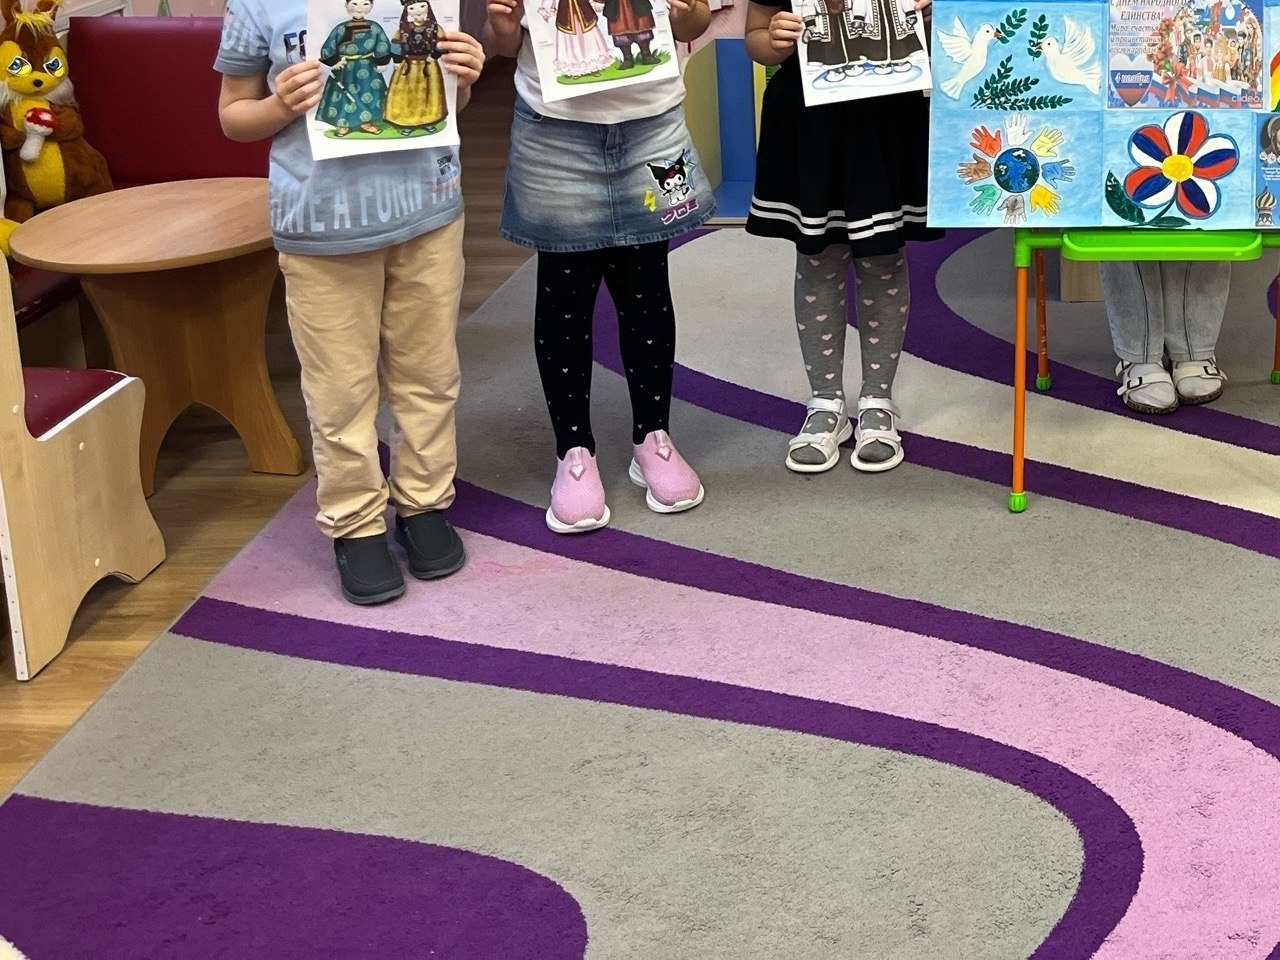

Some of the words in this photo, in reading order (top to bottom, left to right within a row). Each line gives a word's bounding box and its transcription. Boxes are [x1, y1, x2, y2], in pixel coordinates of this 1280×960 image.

[1120, 11, 1164, 21] ЕДИНСТВА!
[1115, 72, 1121, 83] 4
[1121, 72, 1150, 86] ноября
